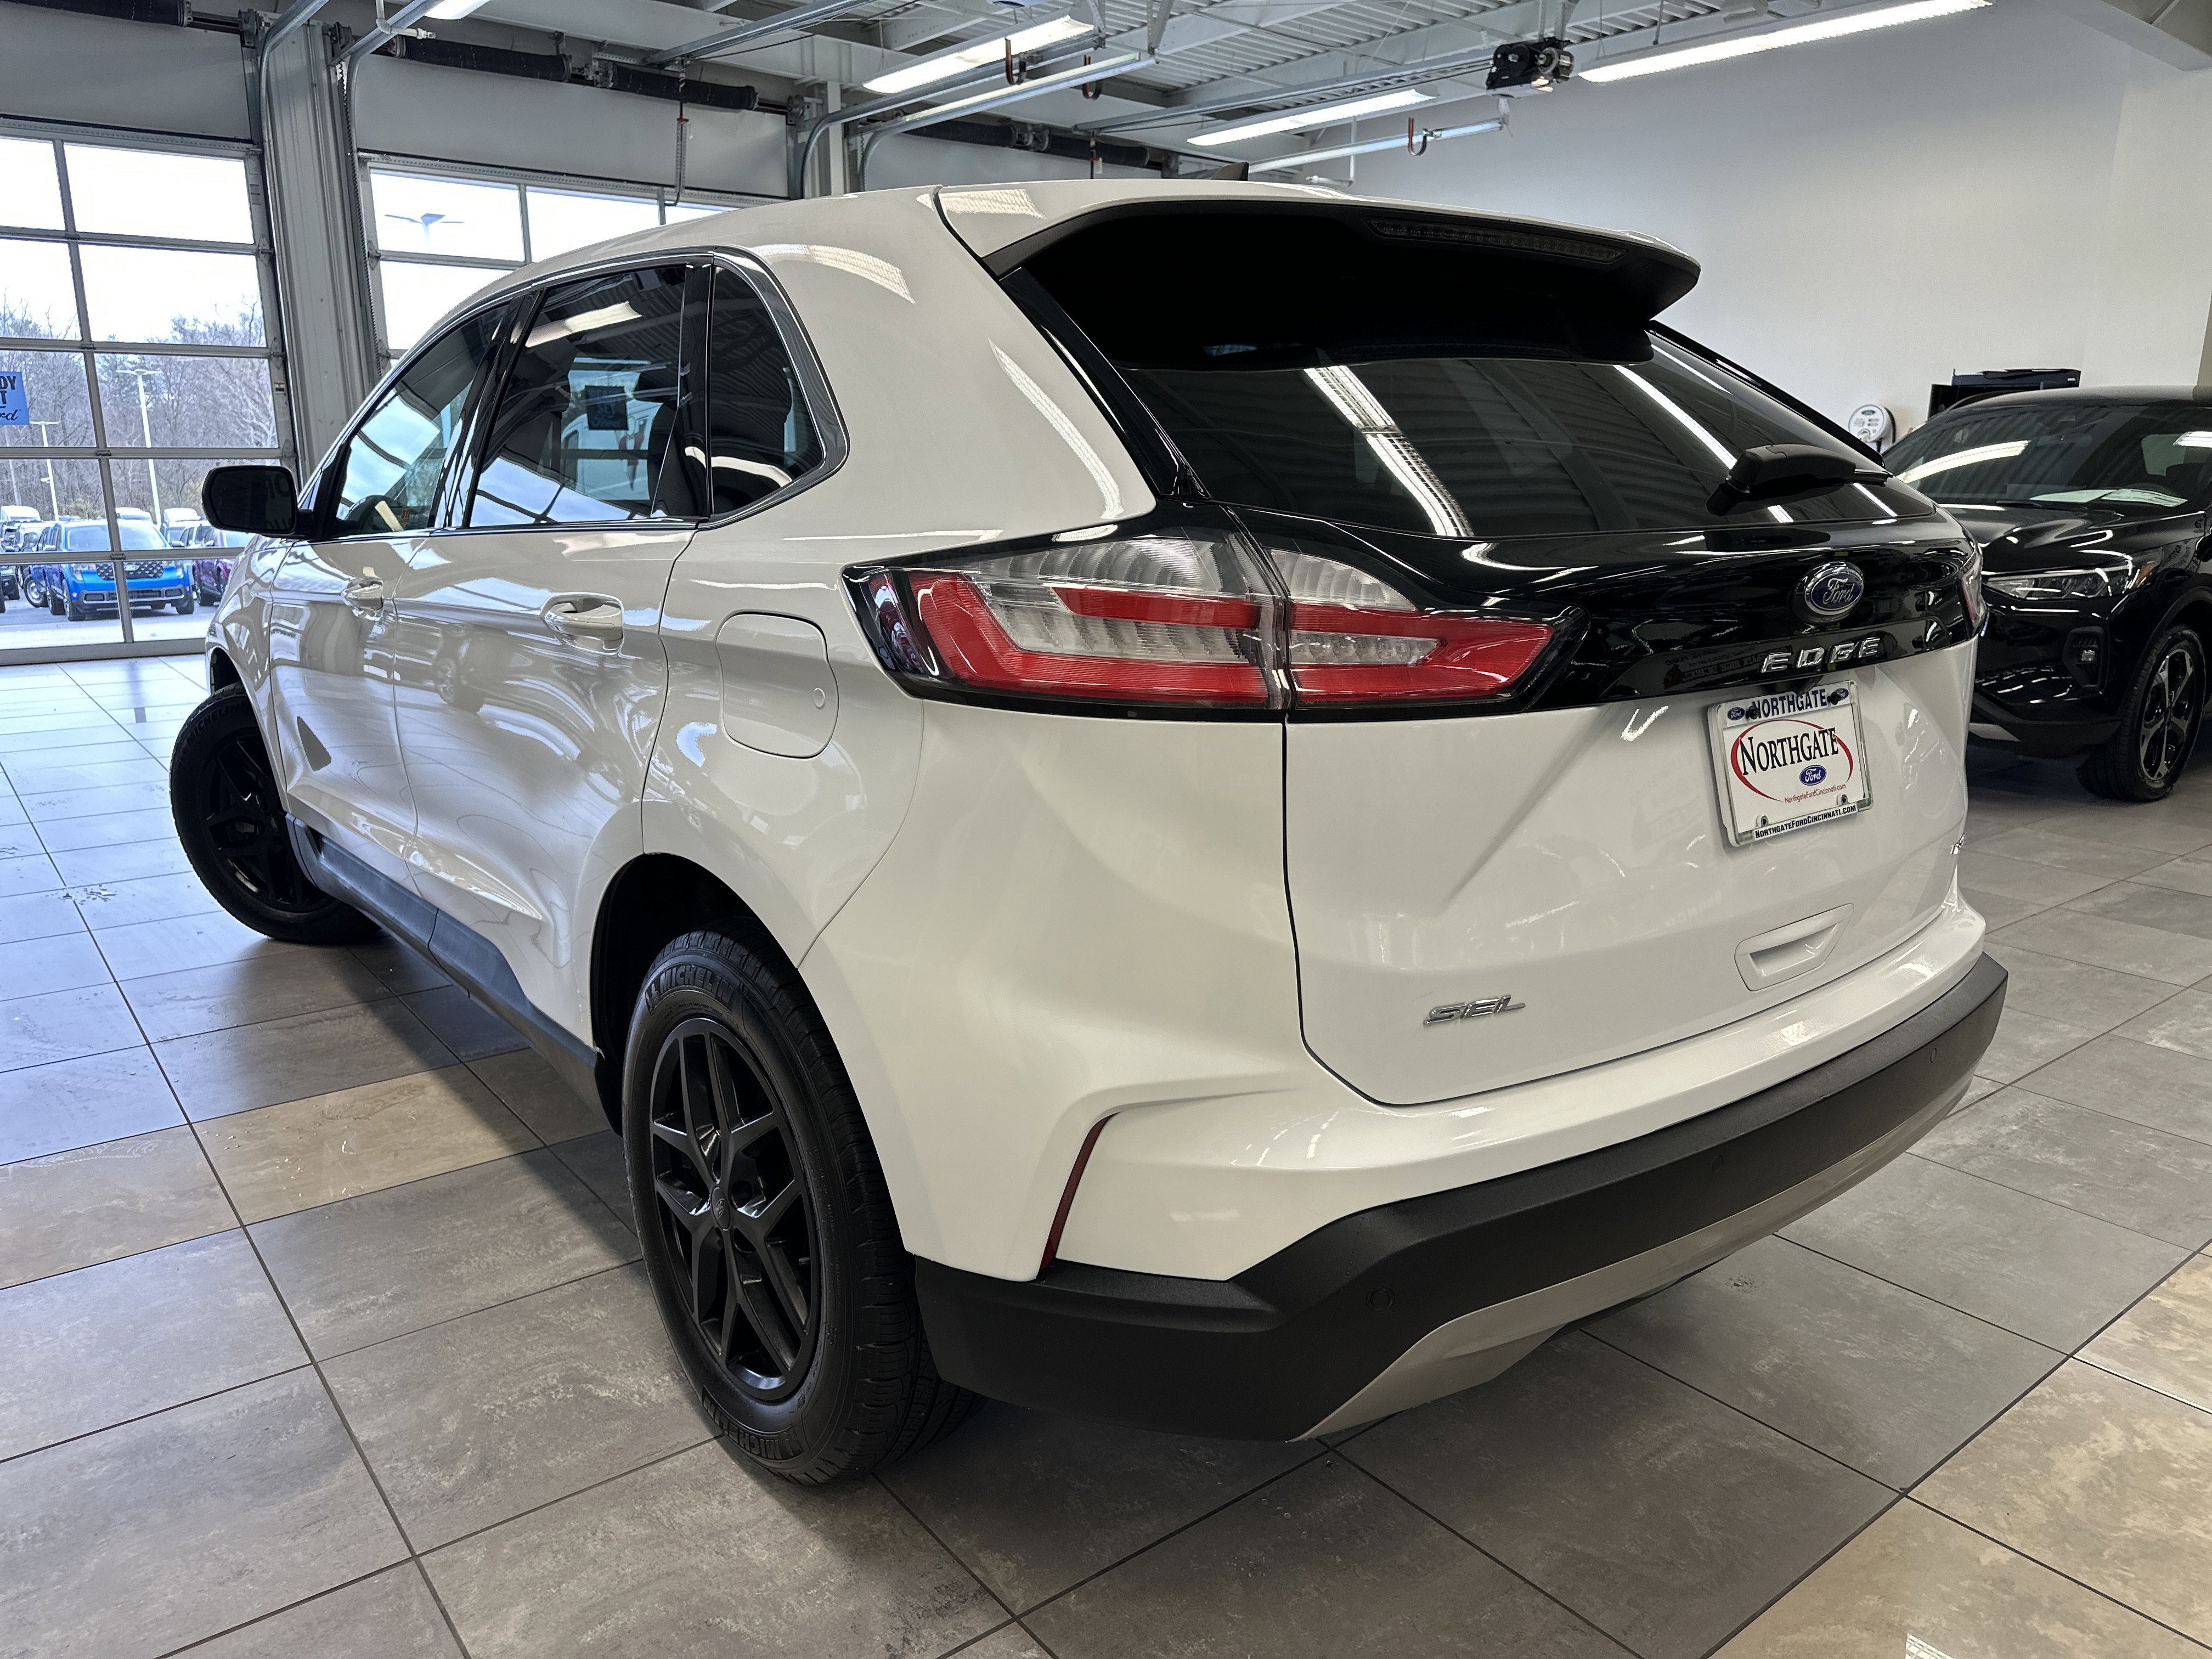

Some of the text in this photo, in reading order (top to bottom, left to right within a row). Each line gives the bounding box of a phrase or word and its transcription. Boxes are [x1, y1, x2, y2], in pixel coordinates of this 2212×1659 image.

[1823, 578, 1855, 605] Ford
[1760, 637, 1881, 673] EDGE
[1730, 709, 1742, 718] Ford
[1751, 689, 1827, 719] NORTHGATE
[1739, 727, 1839, 776] NORTHGATE
[1804, 768, 1822, 783] Ford
[1784, 783, 1847, 804] NorthgateFordCincinnati.com
[659, 964, 735, 1003] MICHELIN
[1423, 994, 1526, 1025] SEL
